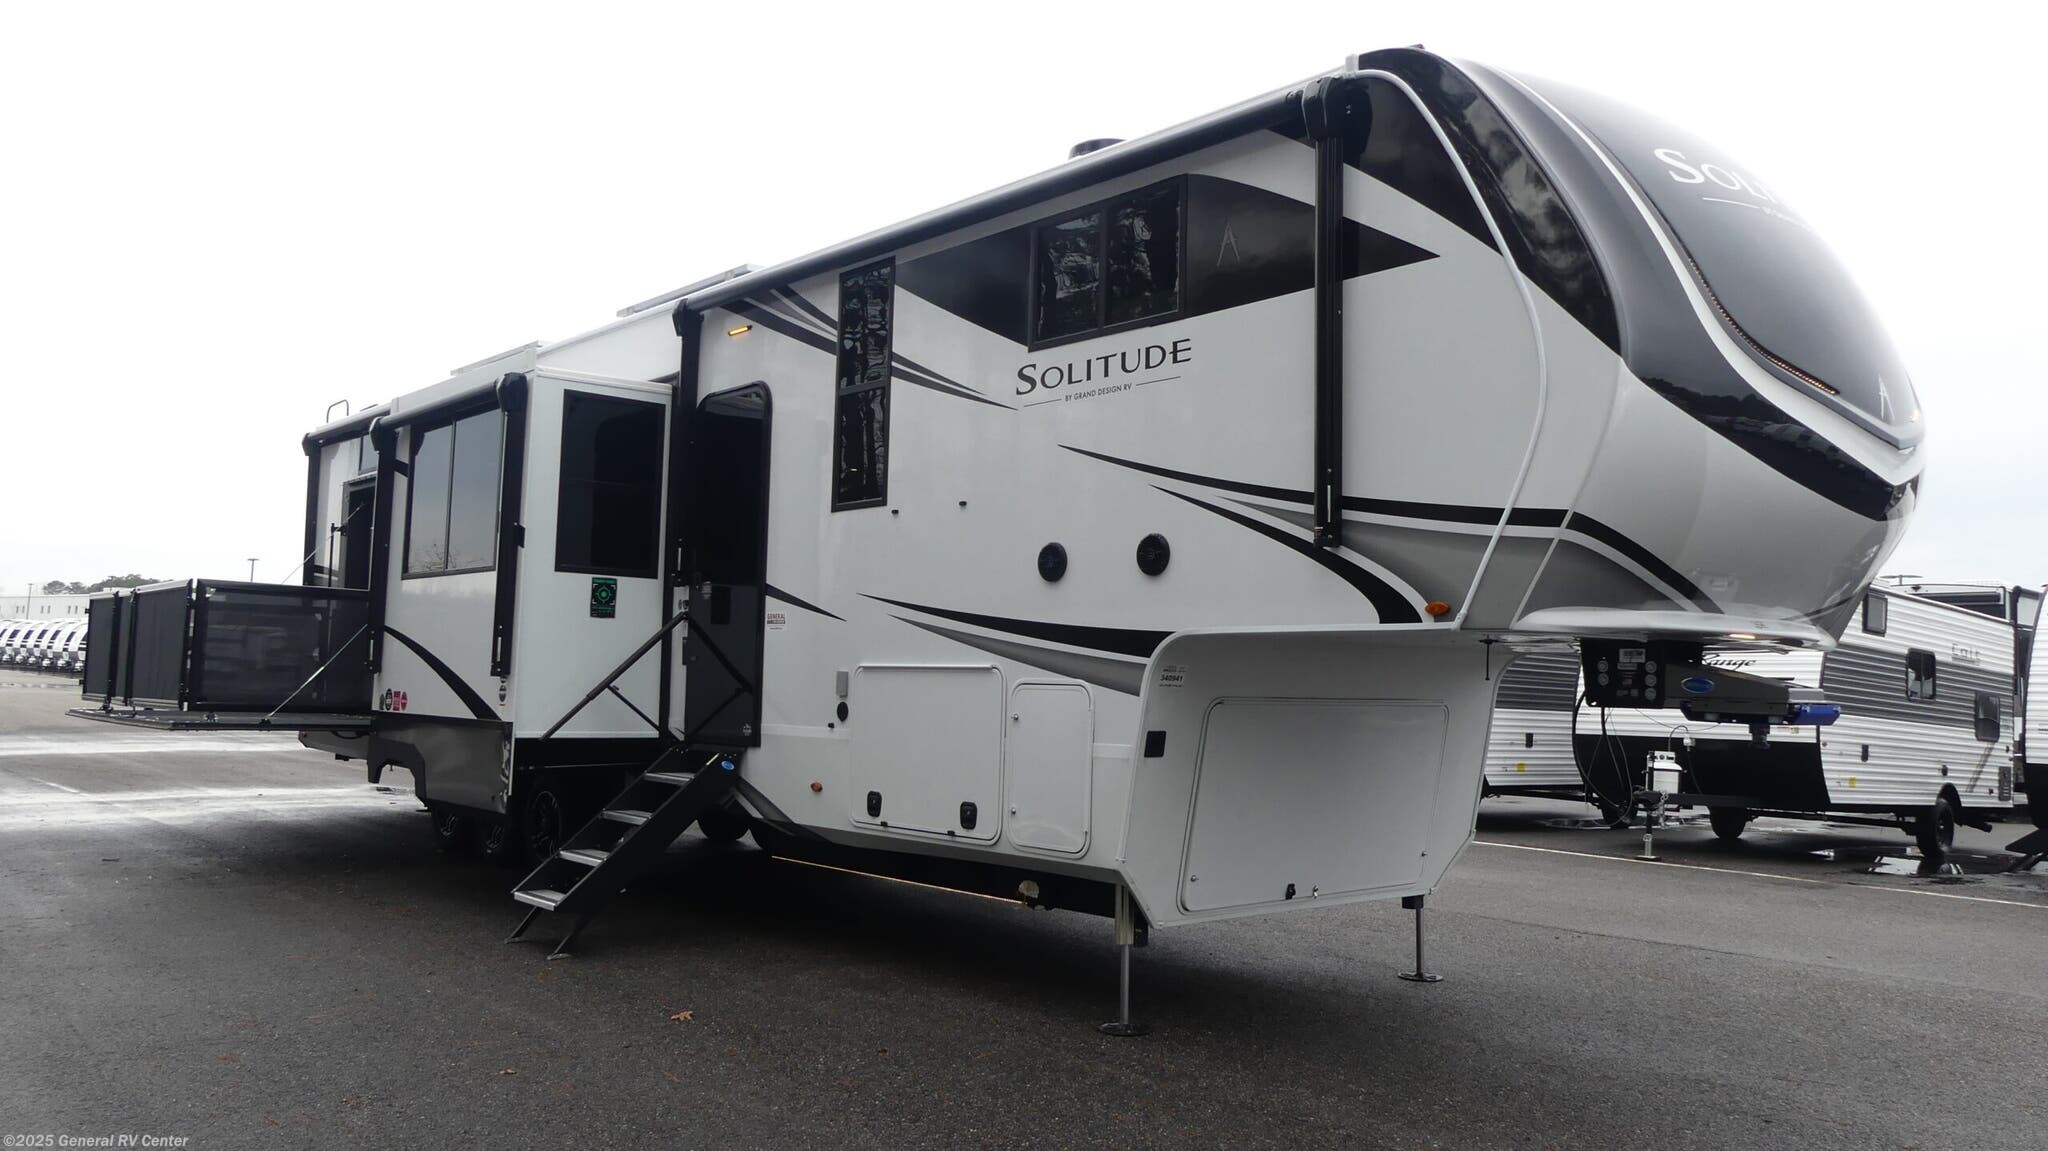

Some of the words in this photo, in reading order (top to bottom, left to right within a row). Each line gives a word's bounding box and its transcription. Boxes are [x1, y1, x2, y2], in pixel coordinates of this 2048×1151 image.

[1016, 338, 1192, 396] SOLITUDE
[1064, 394, 1073, 402] BY
[1073, 389, 1096, 401] GRAND
[1098, 384, 1122, 397] DESIGN
[1123, 382, 1133, 392] RV
